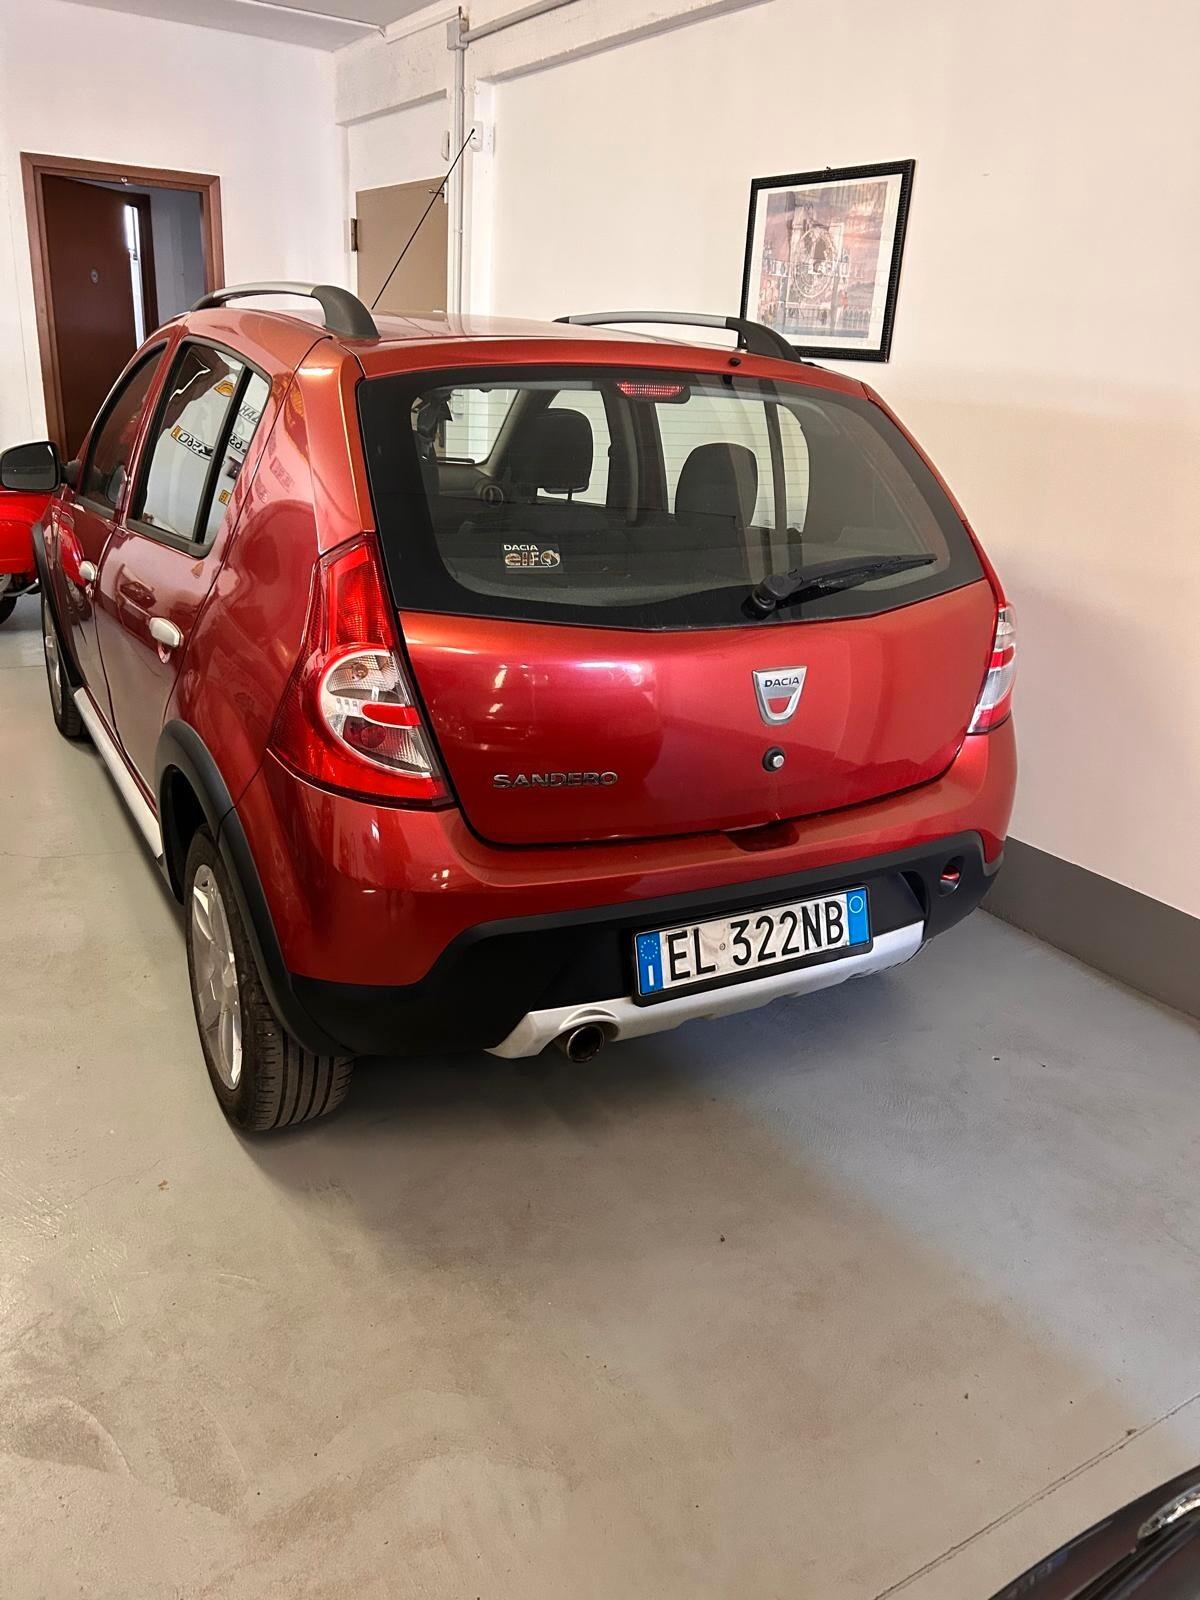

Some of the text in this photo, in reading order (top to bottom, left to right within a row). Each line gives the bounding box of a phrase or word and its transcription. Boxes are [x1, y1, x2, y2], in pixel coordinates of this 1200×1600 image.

[764, 676, 800, 688] DACIA
[492, 771, 618, 789] SANDERO
[666, 927, 717, 981] EL
[730, 900, 844, 966] 322NB
